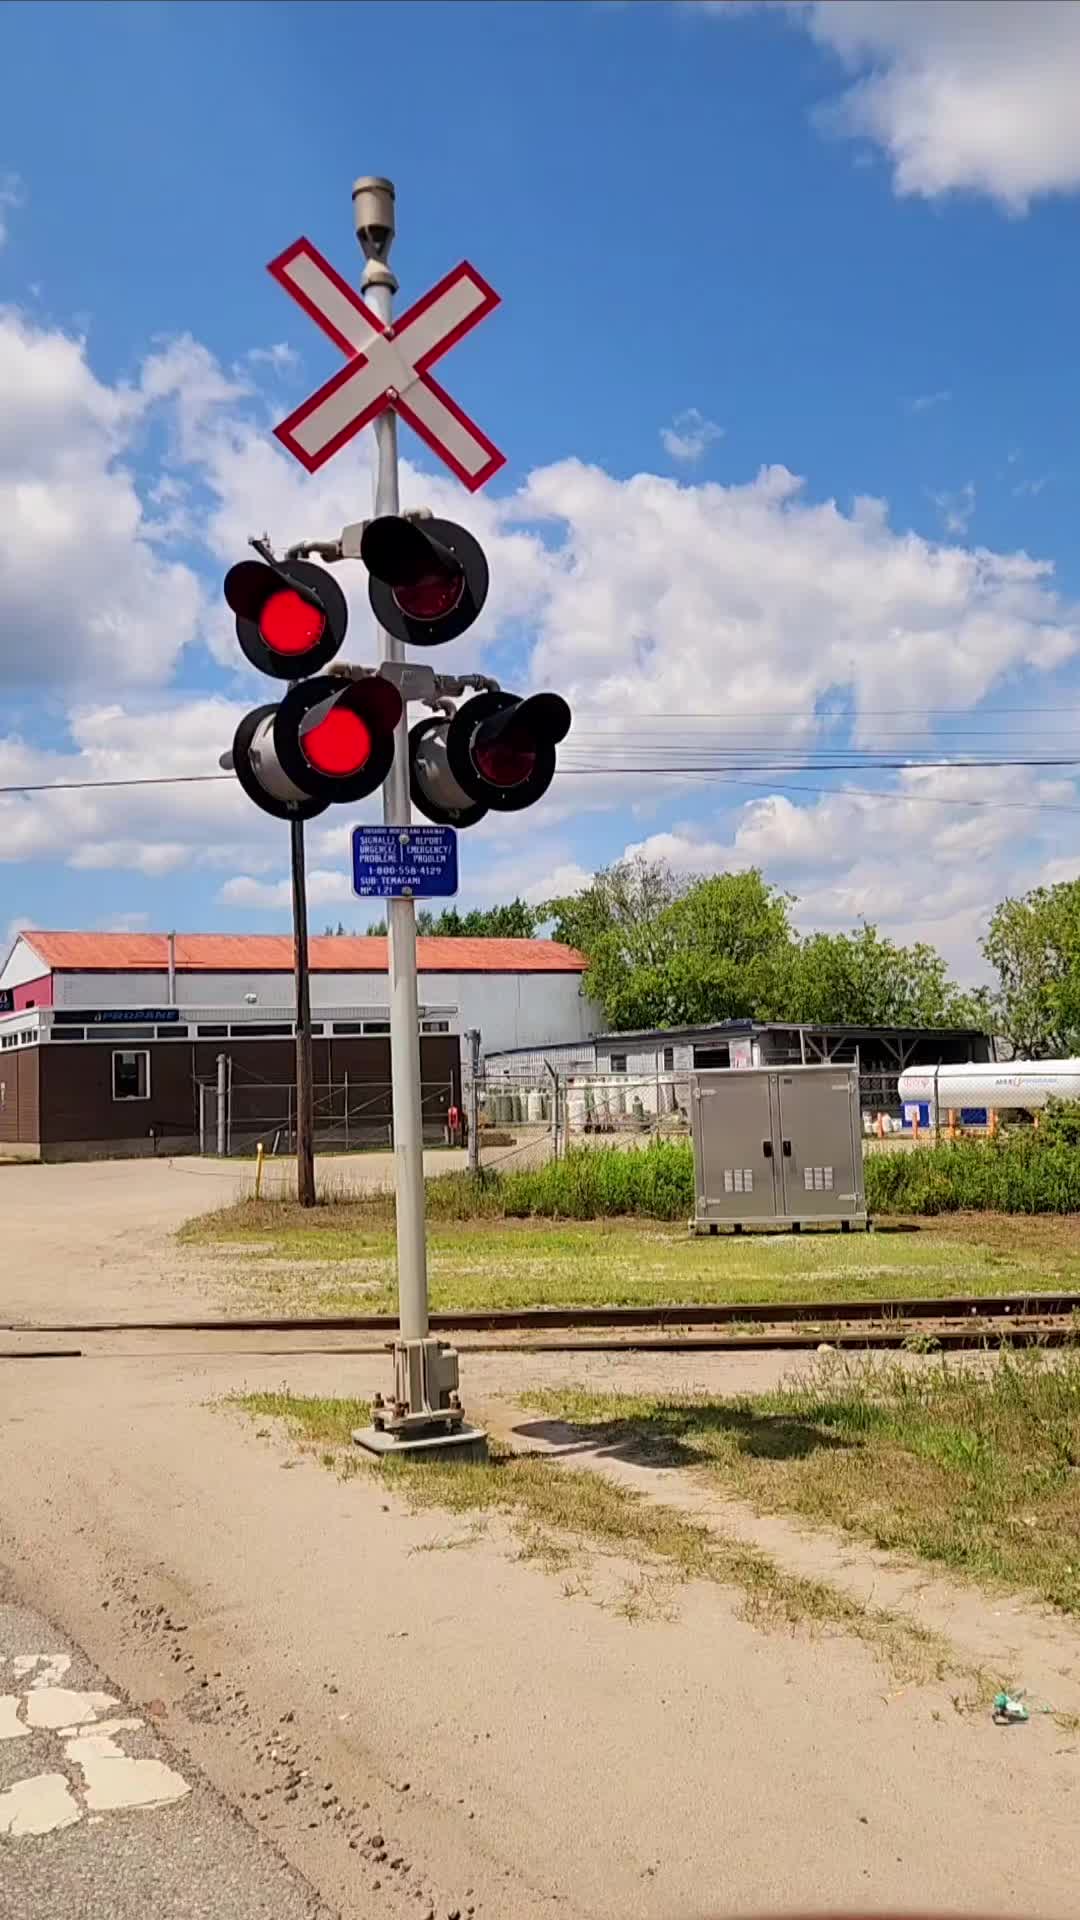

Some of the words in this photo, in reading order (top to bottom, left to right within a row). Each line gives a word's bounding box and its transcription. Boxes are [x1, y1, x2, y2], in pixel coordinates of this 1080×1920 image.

[415, 836, 443, 845] REPORT
[406, 845, 452, 855] EMERGENCY/
[413, 854, 446, 863] PROBLEM
[381, 876, 421, 885] TEMAGAMI
[102, 1010, 177, 1021] PROPANE
